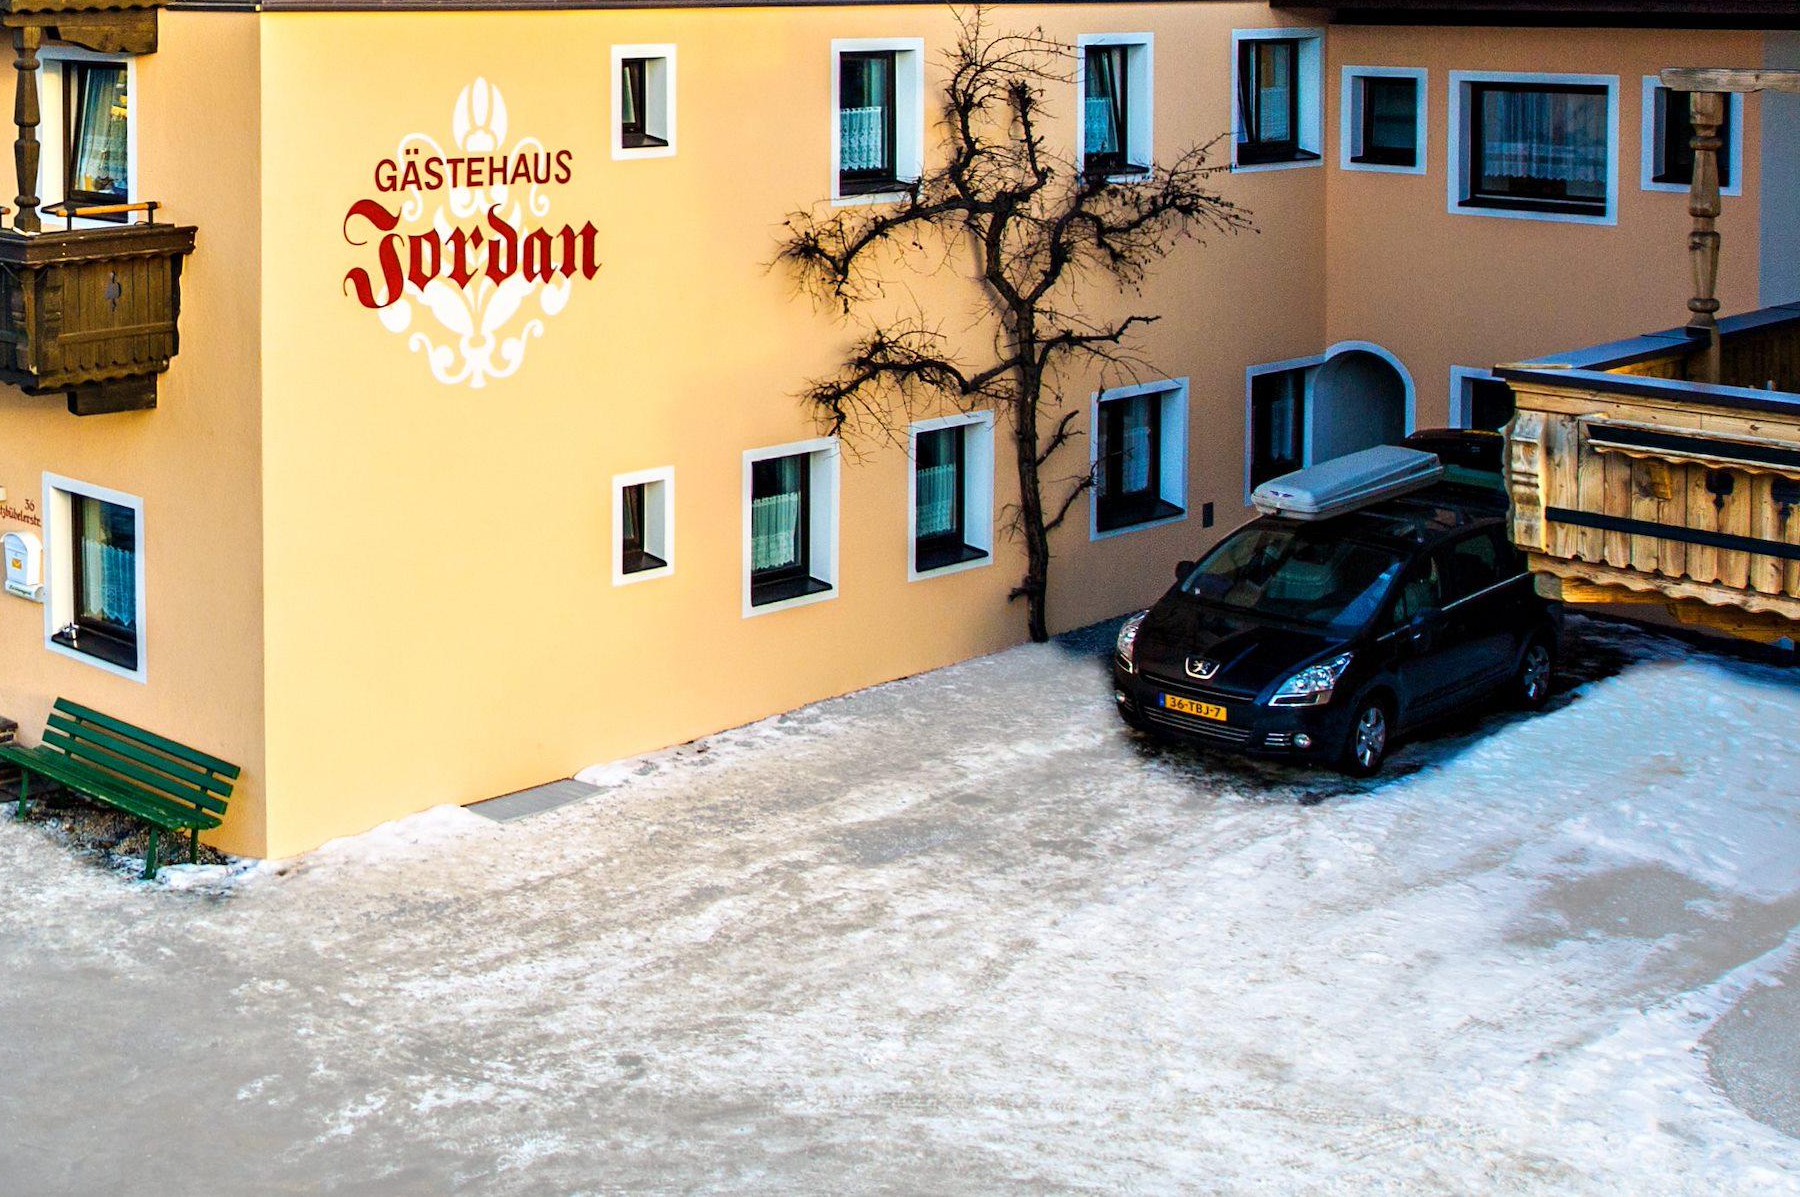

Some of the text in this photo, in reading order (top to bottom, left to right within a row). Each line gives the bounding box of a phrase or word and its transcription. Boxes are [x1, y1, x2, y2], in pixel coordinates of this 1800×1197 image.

[374, 148, 573, 192] GÄSTEHAUS
[343, 199, 603, 309] Jordan
[24, 498, 35, 512] 36
[1169, 697, 1221, 718] 36-TBJ-7
